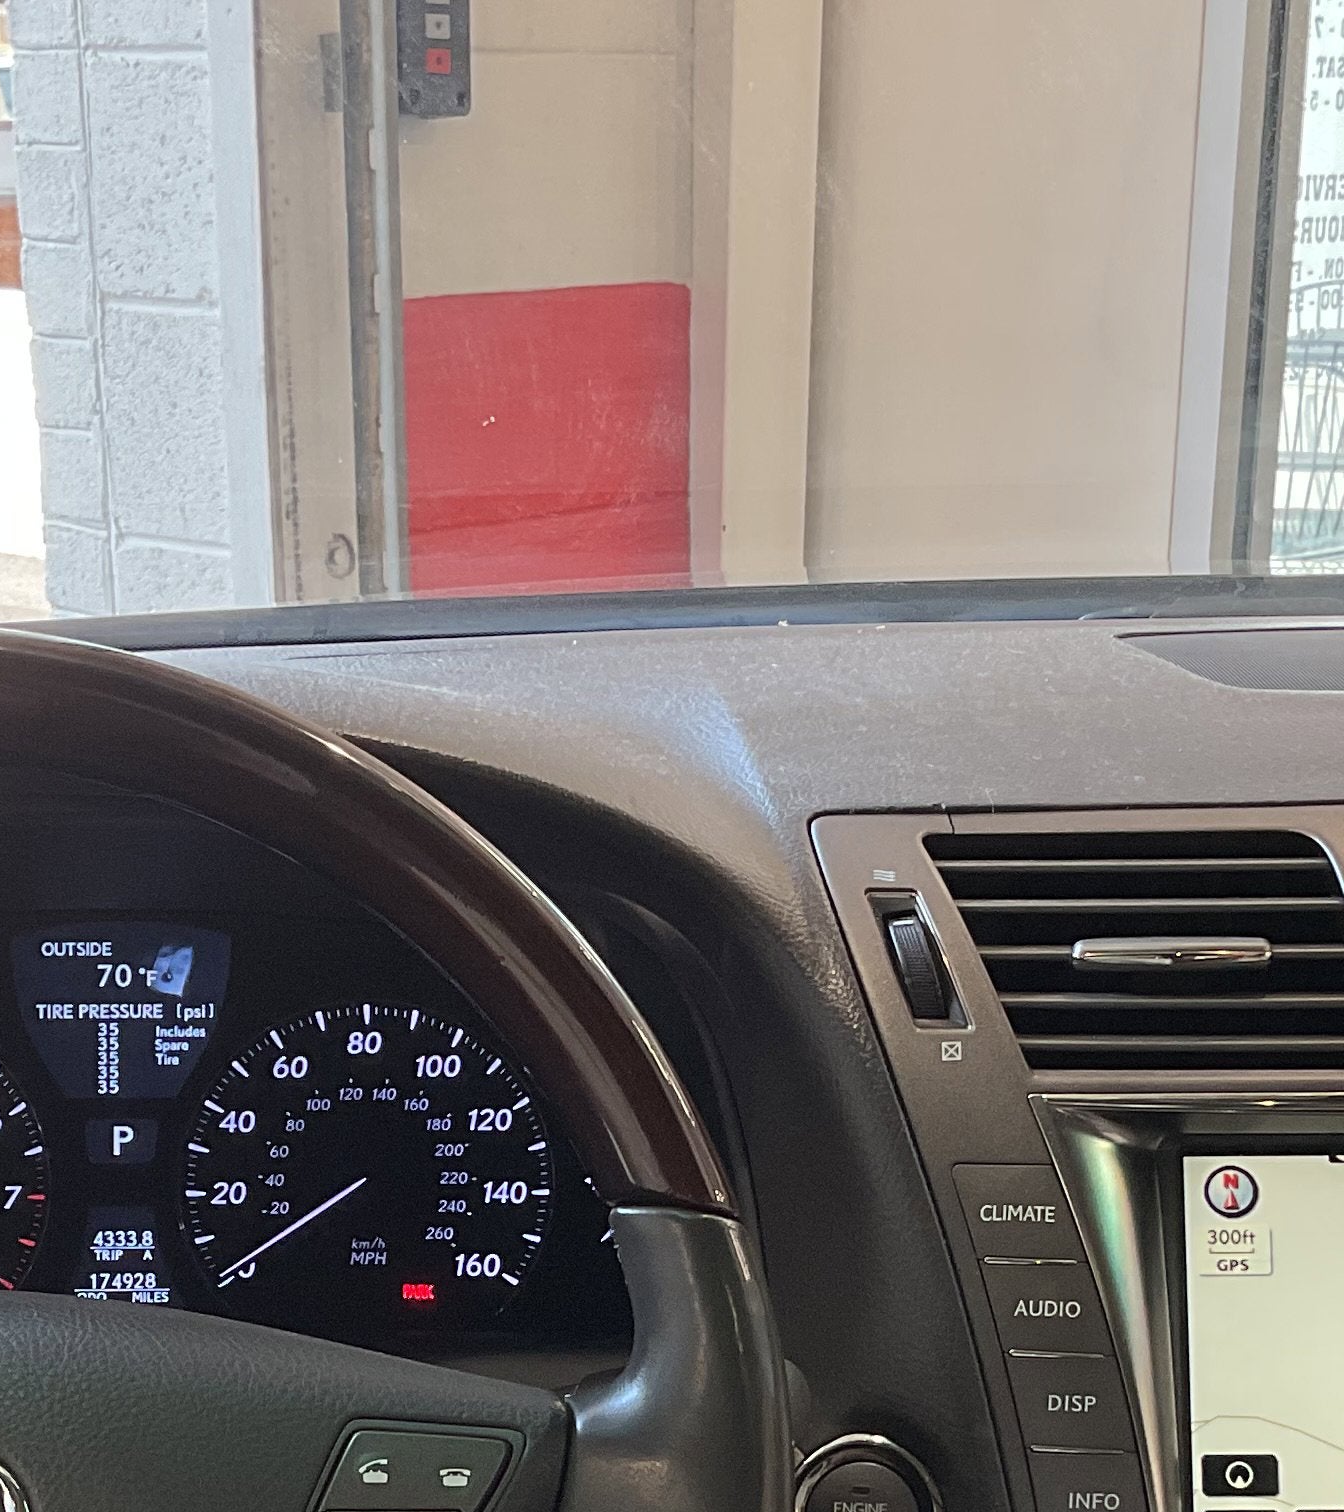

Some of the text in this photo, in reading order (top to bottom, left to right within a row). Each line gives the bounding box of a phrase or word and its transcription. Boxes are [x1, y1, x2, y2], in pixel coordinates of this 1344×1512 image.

[40, 941, 113, 957] OUTSIDE
[35, 1003, 74, 1019] TIRE
[78, 1003, 164, 1019] PRESSURE
[97, 1022, 120, 1036] 35
[155, 1025, 206, 1038] Includes
[97, 1037, 120, 1051] 35
[154, 1040, 190, 1052] Spare
[346, 1031, 383, 1055] 80
[97, 1051, 120, 1065] 35
[155, 1053, 180, 1066] Tire
[97, 1066, 120, 1080] 35
[272, 1055, 309, 1079] 60
[415, 1054, 462, 1078] 100
[97, 1080, 120, 1095] 35
[339, 1087, 364, 1101] 120
[371, 1087, 397, 1101] 140
[305, 1098, 332, 1112] 100
[403, 1098, 430, 1112] 160
[218, 1110, 256, 1133] 40
[285, 1118, 306, 1132] 80
[425, 1118, 452, 1132] 180
[468, 1108, 513, 1132] 120
[112, 1125, 135, 1156] P
[269, 1145, 290, 1159] 60
[434, 1143, 465, 1157] 200
[264, 1173, 285, 1187] 40
[439, 1171, 469, 1185] 220
[1223, 1173, 1239, 1190] N
[3, 1185, 23, 1210] 7
[210, 1181, 248, 1205] 20
[483, 1181, 528, 1204] 140
[269, 1201, 290, 1215] 20
[437, 1200, 467, 1213] 240
[979, 1204, 1056, 1223] CLIMATE
[92, 1230, 154, 1247] 4333.8
[424, 1226, 454, 1240] 260
[1207, 1229, 1256, 1245] 300ft
[350, 1237, 387, 1251] km/h
[93, 1249, 154, 1261] TRIP A
[349, 1251, 387, 1266] MPH
[455, 1253, 501, 1277] 160
[1216, 1259, 1249, 1272] GPS
[89, 1272, 157, 1290] 174928
[131, 1291, 170, 1304] MILES
[1013, 1300, 1082, 1318] AUDIO
[1046, 1394, 1097, 1412] DISP
[1067, 1492, 1120, 1511] INFO
